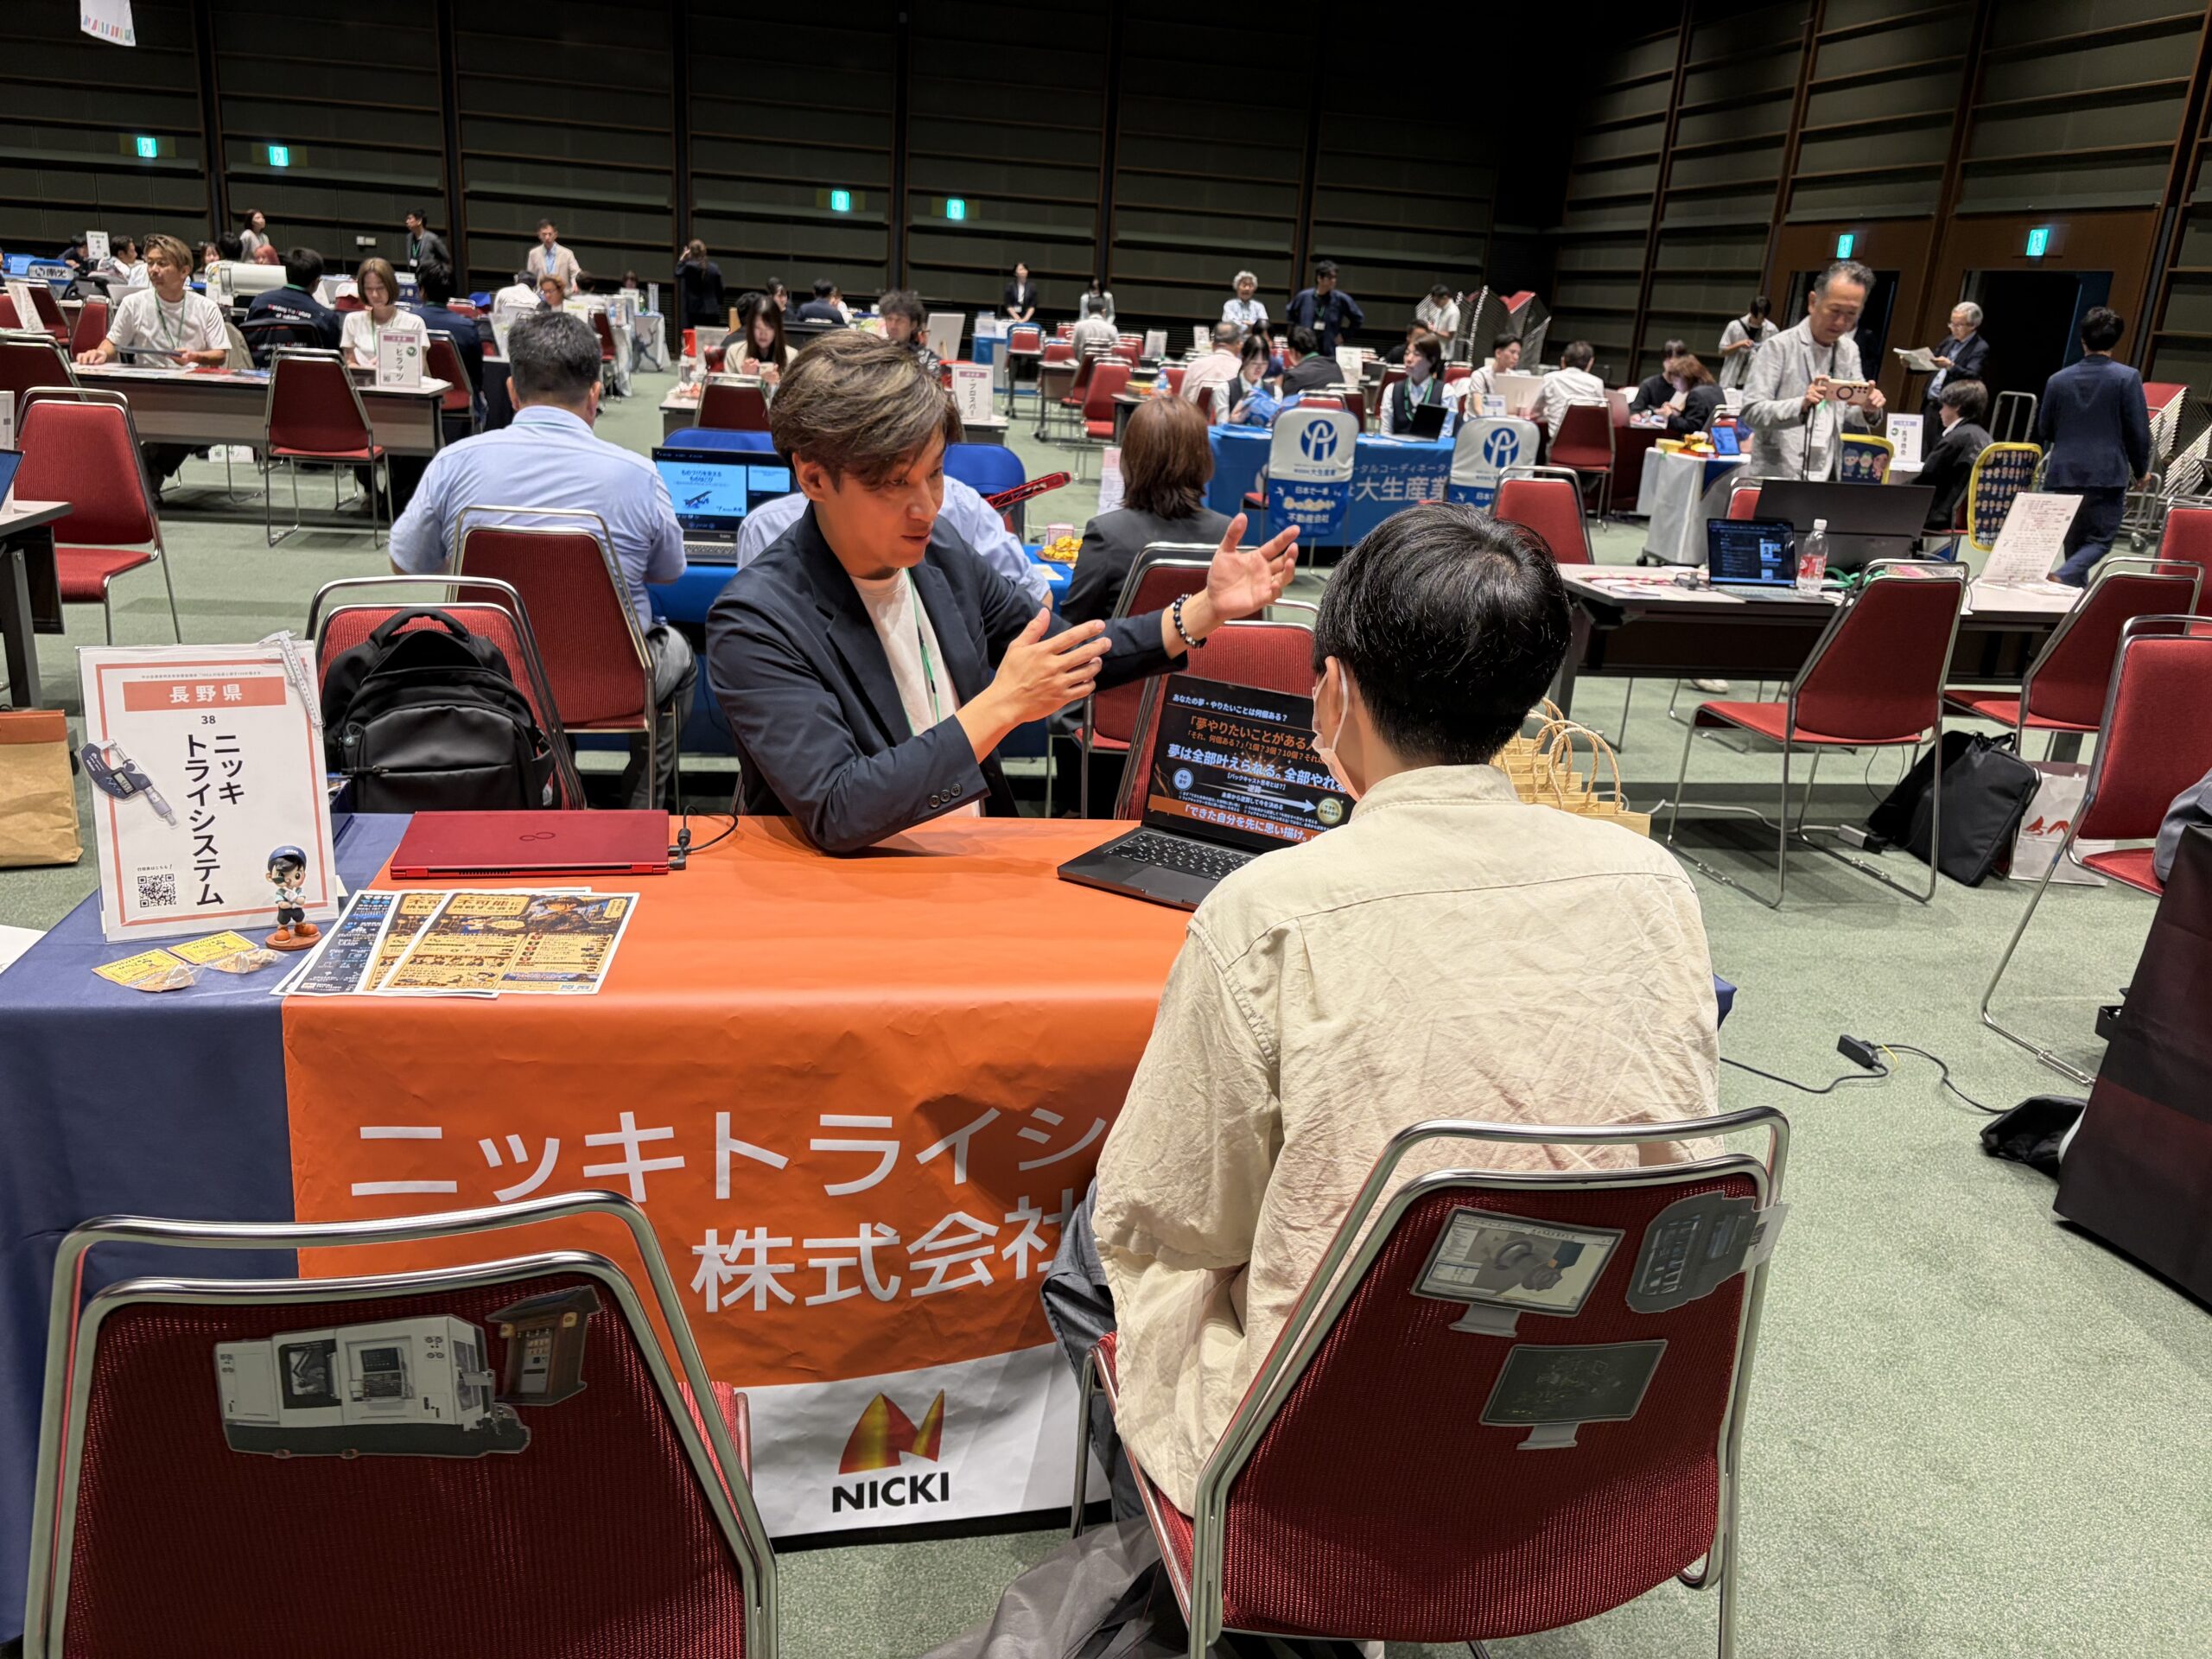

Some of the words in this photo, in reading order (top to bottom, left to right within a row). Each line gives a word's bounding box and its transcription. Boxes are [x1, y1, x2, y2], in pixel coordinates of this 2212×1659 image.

[1348, 476, 1448, 501] 大生産業
[169, 683, 243, 703] 長野県
[200, 715, 216, 725] 38
[213, 734, 245, 805] ニッキ
[184, 734, 224, 906] トライシステム
[351, 1108, 1107, 1203] ニッキトライシ
[831, 1471, 950, 1514] NICKI
